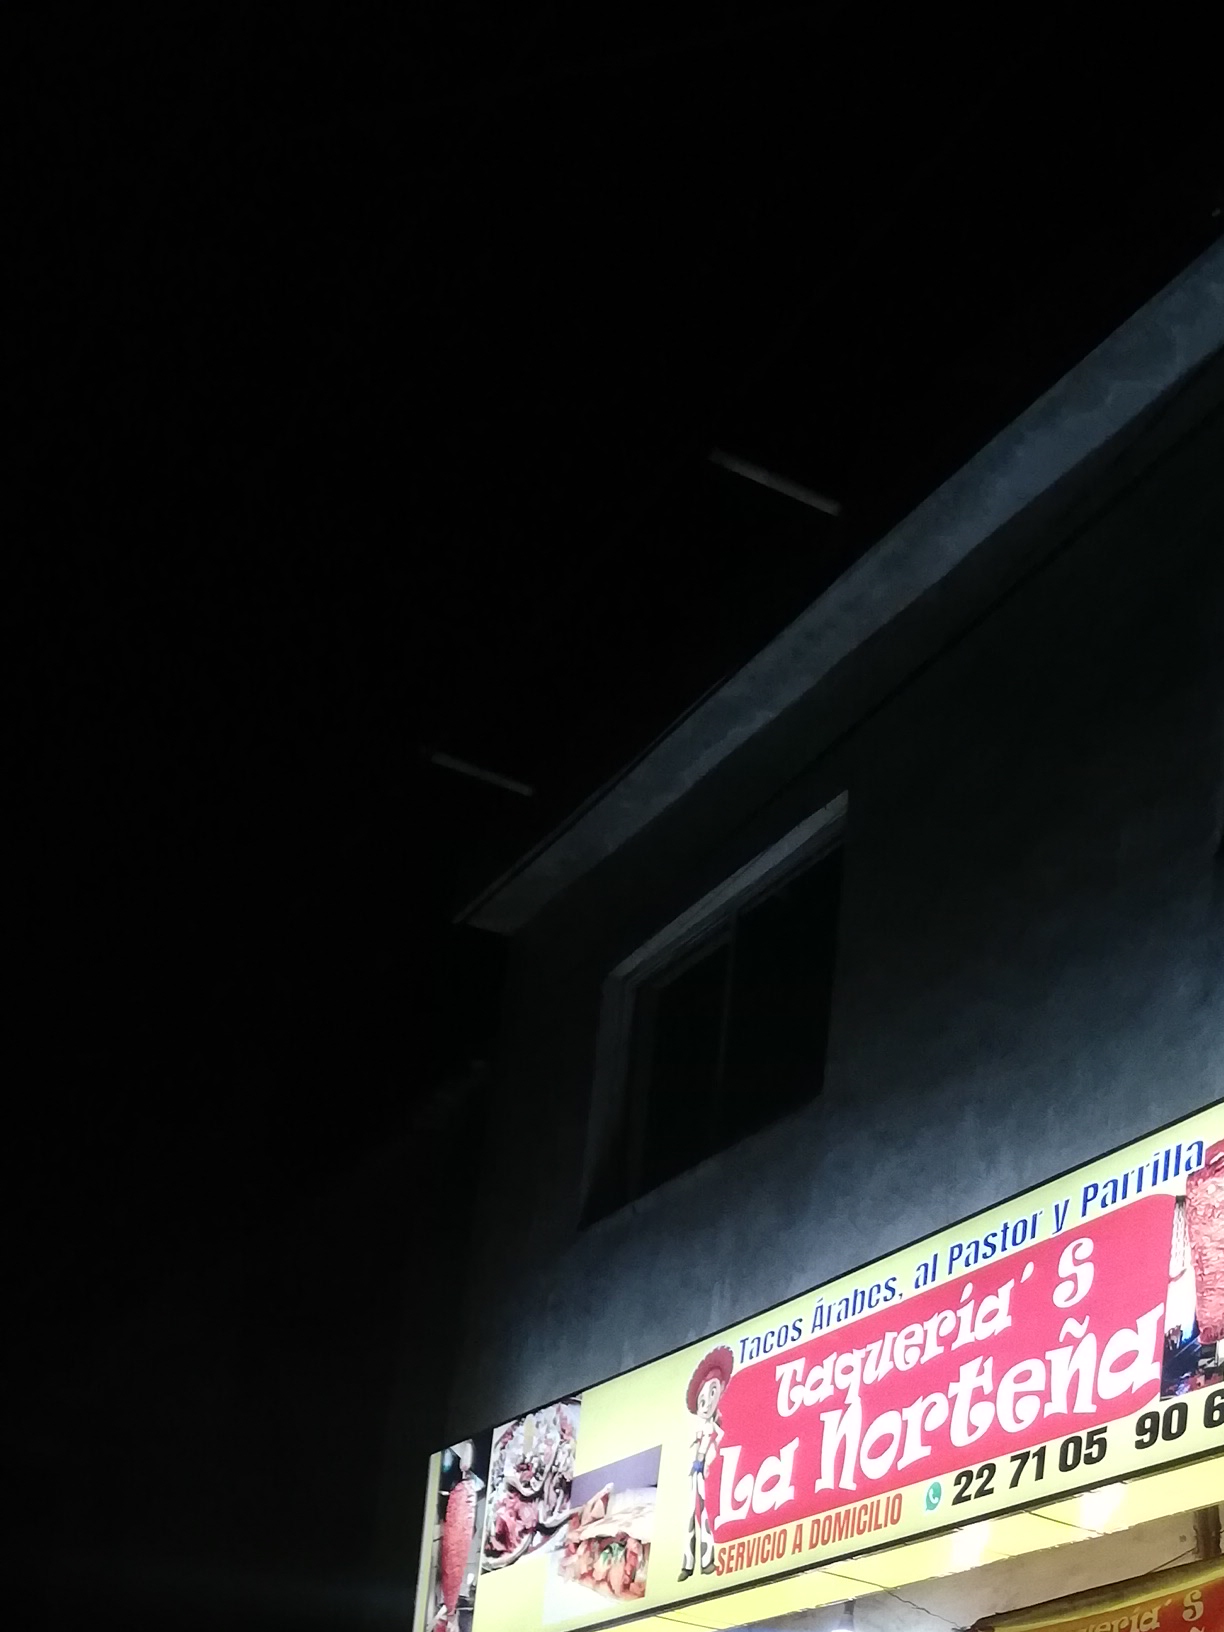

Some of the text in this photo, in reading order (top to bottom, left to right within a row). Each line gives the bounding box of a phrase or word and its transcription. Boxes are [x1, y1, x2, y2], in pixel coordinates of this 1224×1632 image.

[739, 1318, 804, 1365] Tacos
[914, 1252, 939, 1290] al
[948, 1210, 1043, 1276] Pastor
[1052, 1198, 1070, 1235] y
[1081, 1139, 1205, 1218] Parrilla
[713, 1436, 800, 1531] La
[951, 1463, 995, 1506] 22
[1008, 1449, 1046, 1490] 71
[1058, 1426, 1108, 1473] 05
[1134, 1401, 1189, 1450] 90
[715, 1493, 903, 1577] SERVICIO A DOMICILIO
